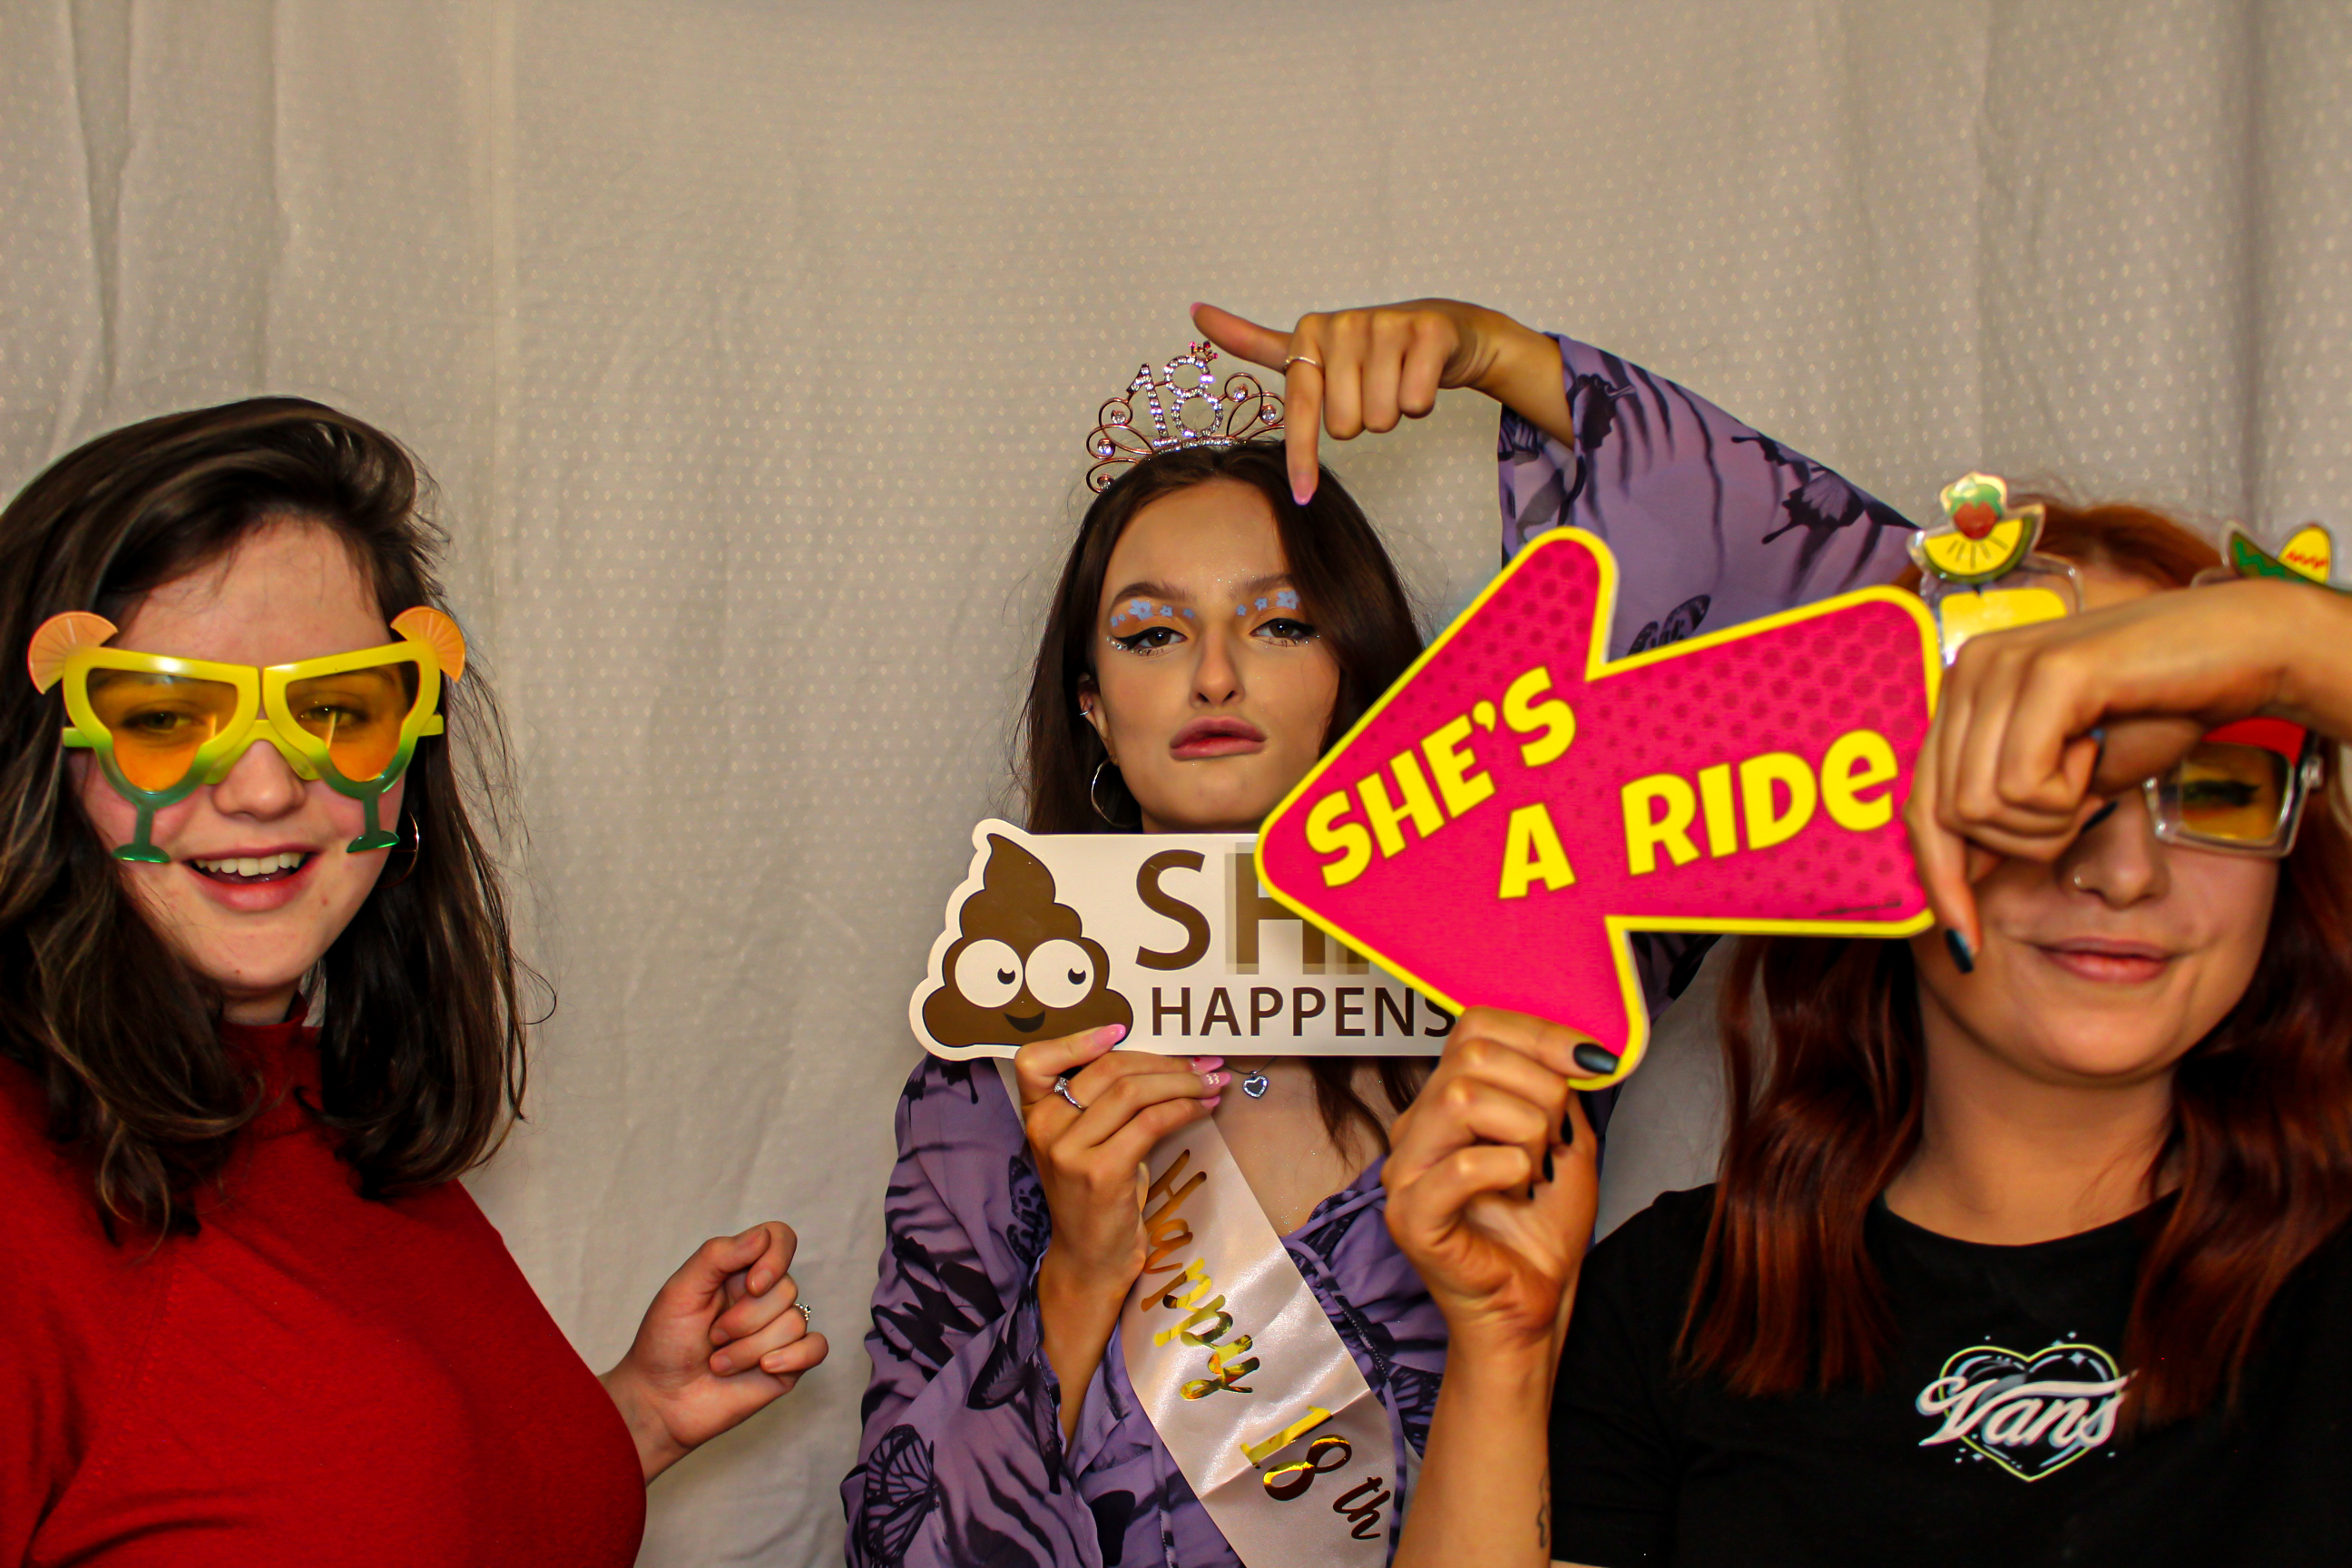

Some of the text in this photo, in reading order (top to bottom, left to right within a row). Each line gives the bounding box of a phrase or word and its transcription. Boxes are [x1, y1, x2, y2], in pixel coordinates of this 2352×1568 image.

[1126, 354, 1224, 446] 18
[1305, 665, 1577, 888] SHE'S
[1498, 802, 1577, 900] A
[1152, 985, 1456, 1038] HAPPENS
[1915, 1369, 2139, 1447] Vans
